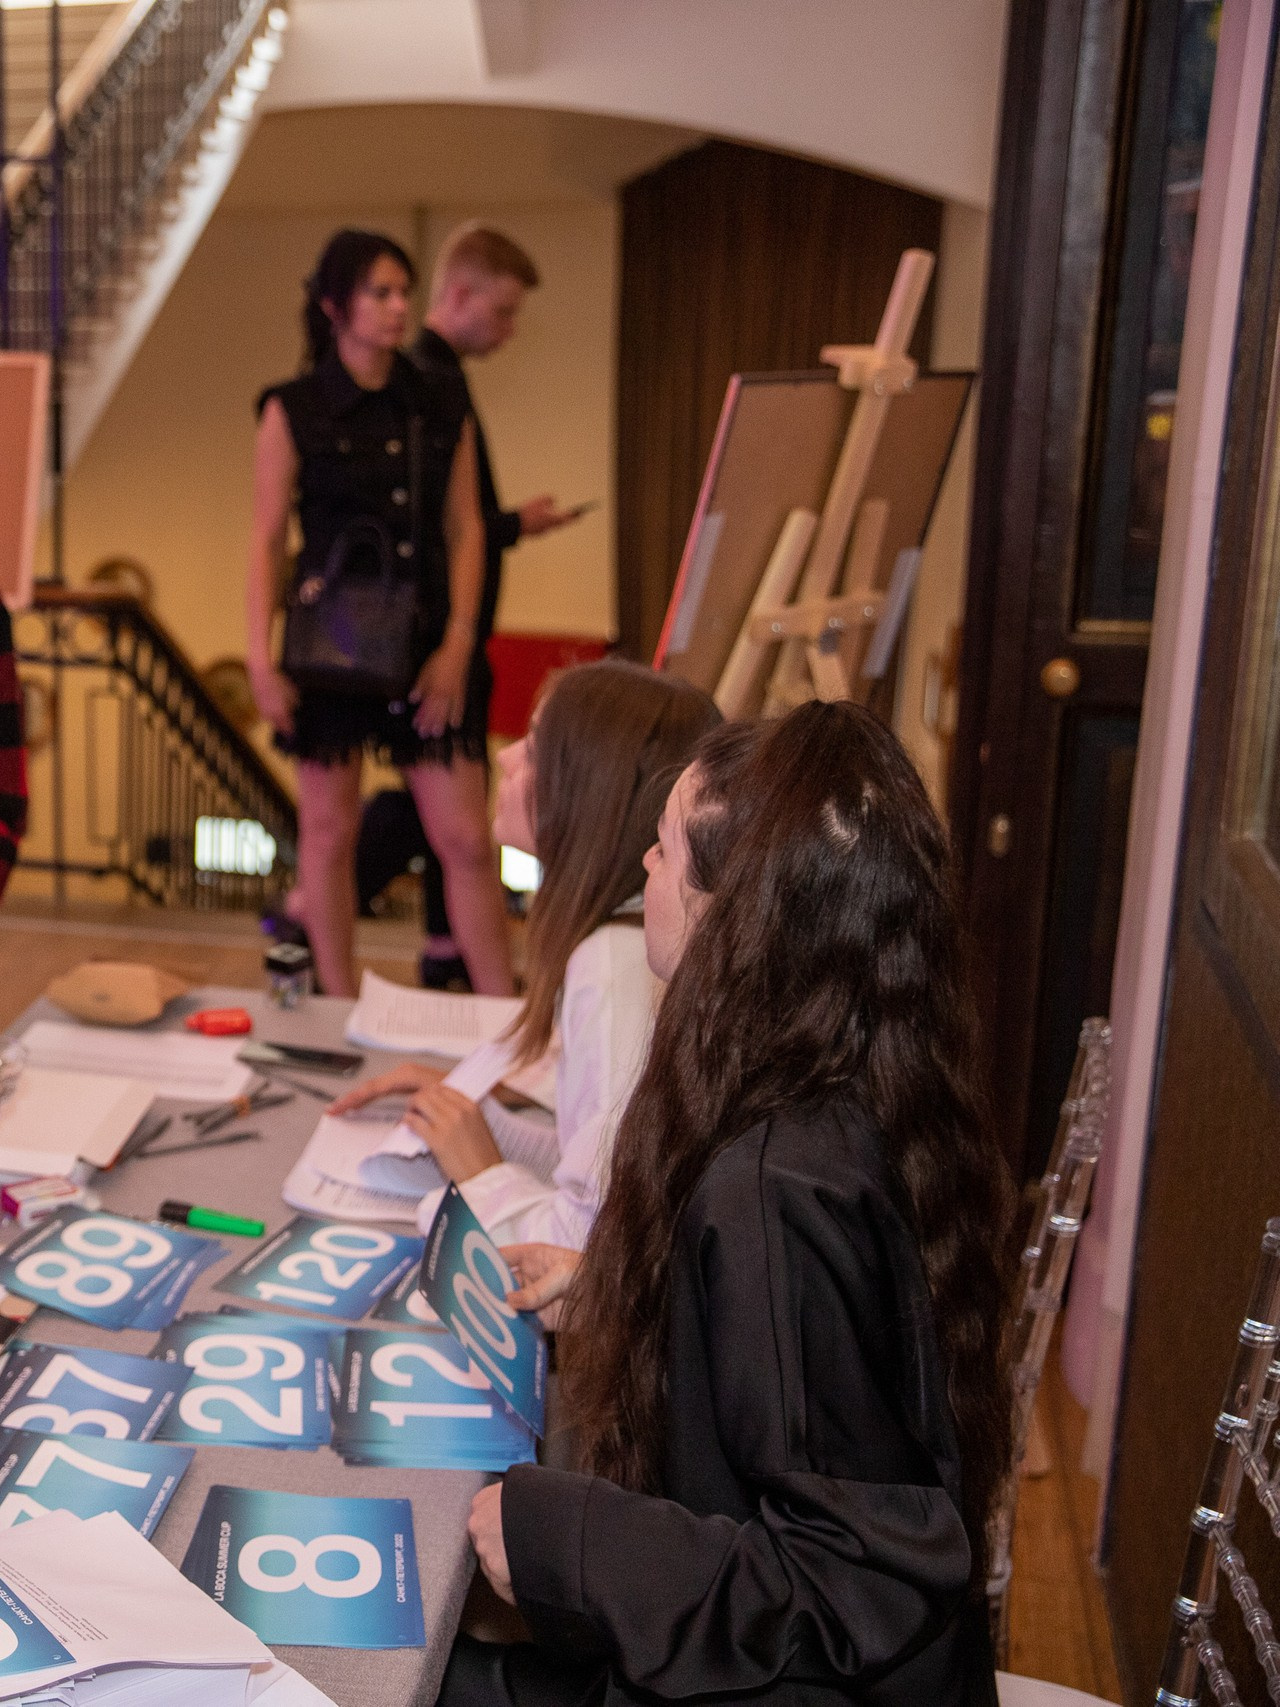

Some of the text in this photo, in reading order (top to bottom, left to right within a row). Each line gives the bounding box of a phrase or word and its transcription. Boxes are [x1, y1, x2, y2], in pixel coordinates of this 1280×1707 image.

[15, 1217, 173, 1307] 89
[255, 1224, 397, 1307] 120
[450, 1229, 518, 1393] 100
[178, 1333, 306, 1437] 29
[370, 1342, 493, 1428] 12
[214, 1521, 231, 1601] LA BOCA SUMMER CUP
[237, 1534, 383, 1599] 8
